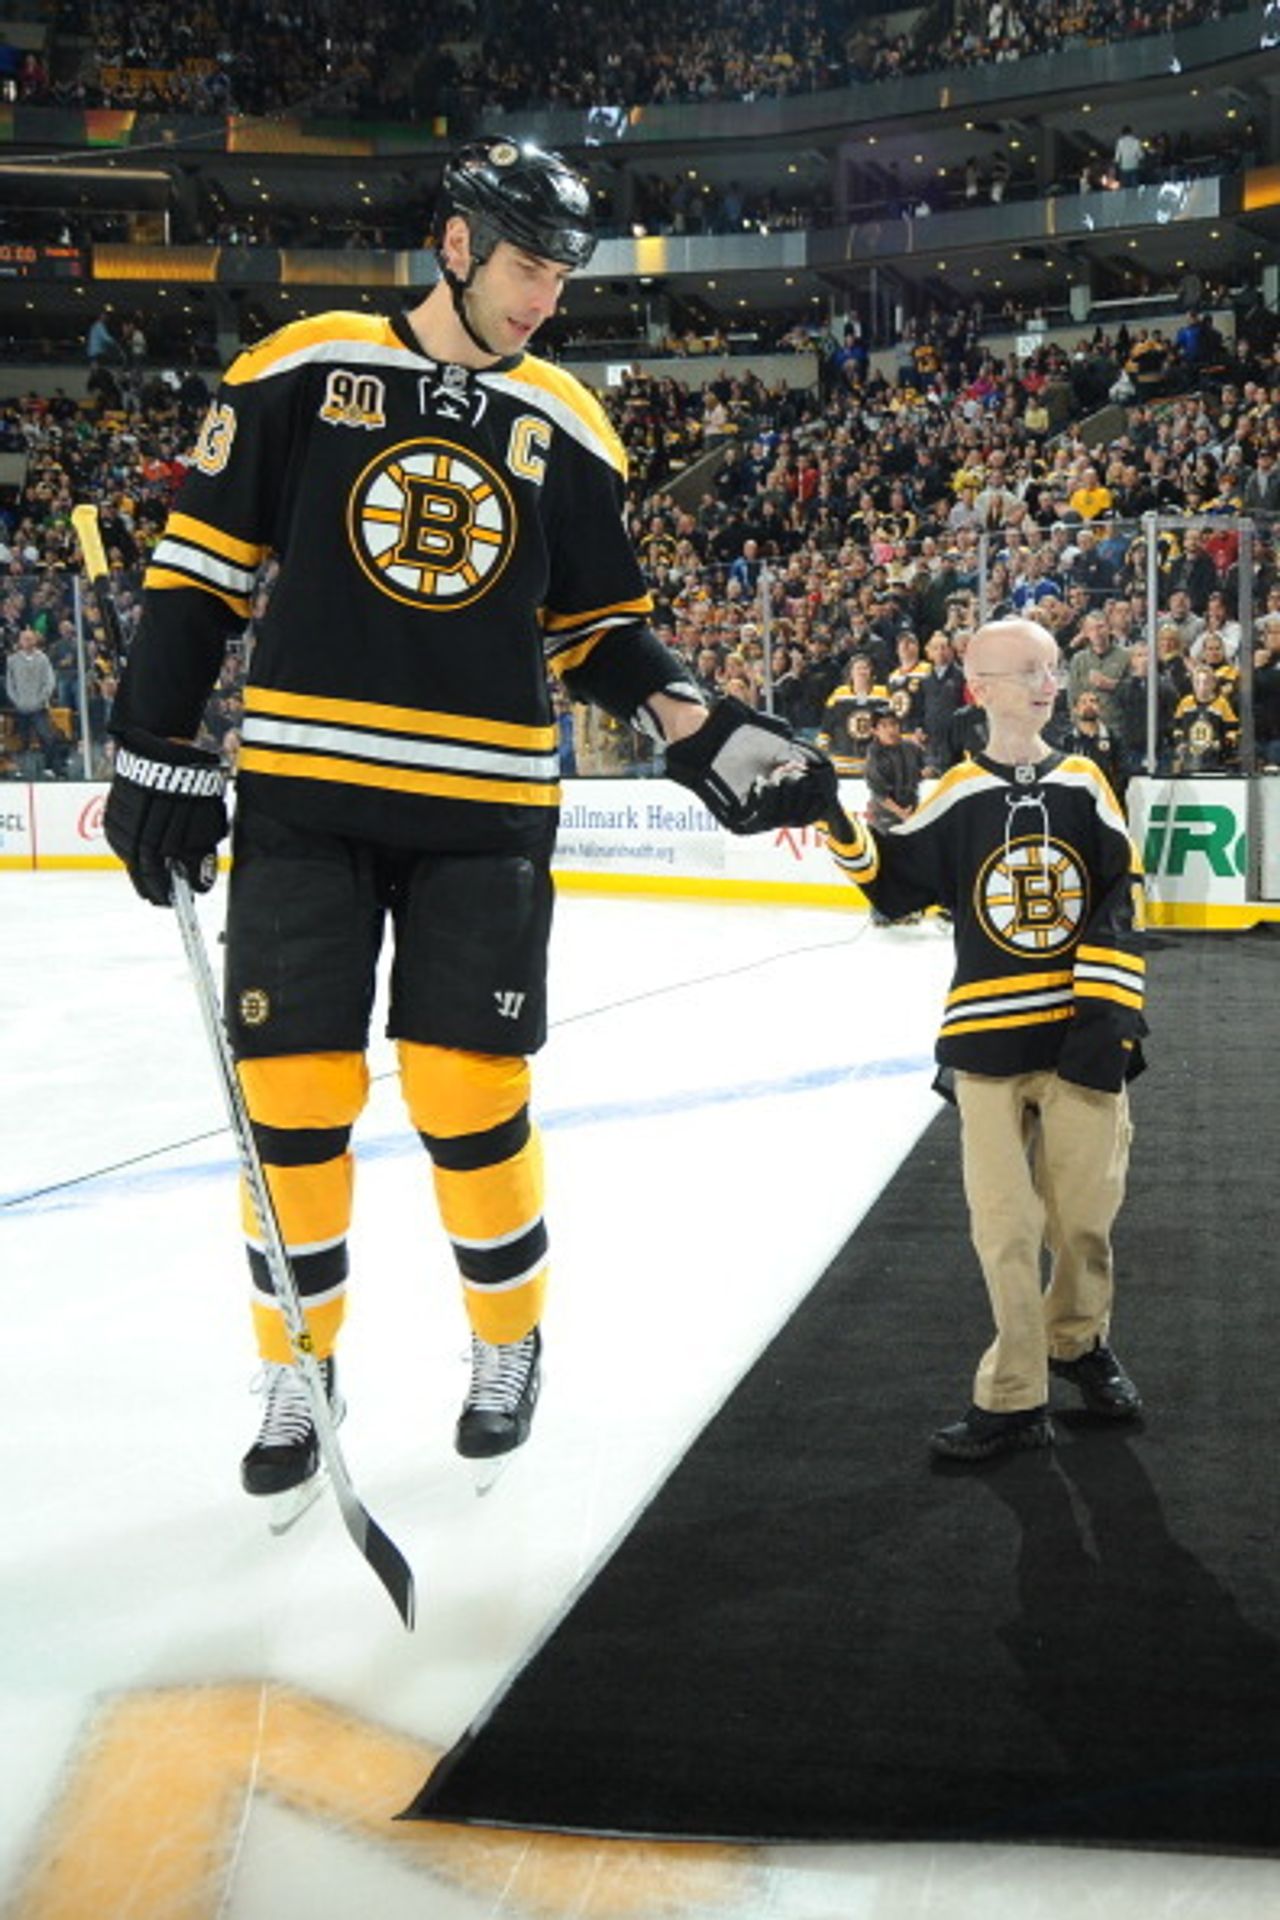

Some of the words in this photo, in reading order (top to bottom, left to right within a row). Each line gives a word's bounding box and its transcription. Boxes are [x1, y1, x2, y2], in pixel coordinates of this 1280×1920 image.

[327, 370, 386, 416] 90
[506, 415, 553, 486] C
[394, 474, 474, 574] B
[559, 805, 639, 829] allmark
[1011, 864, 1065, 933] B
